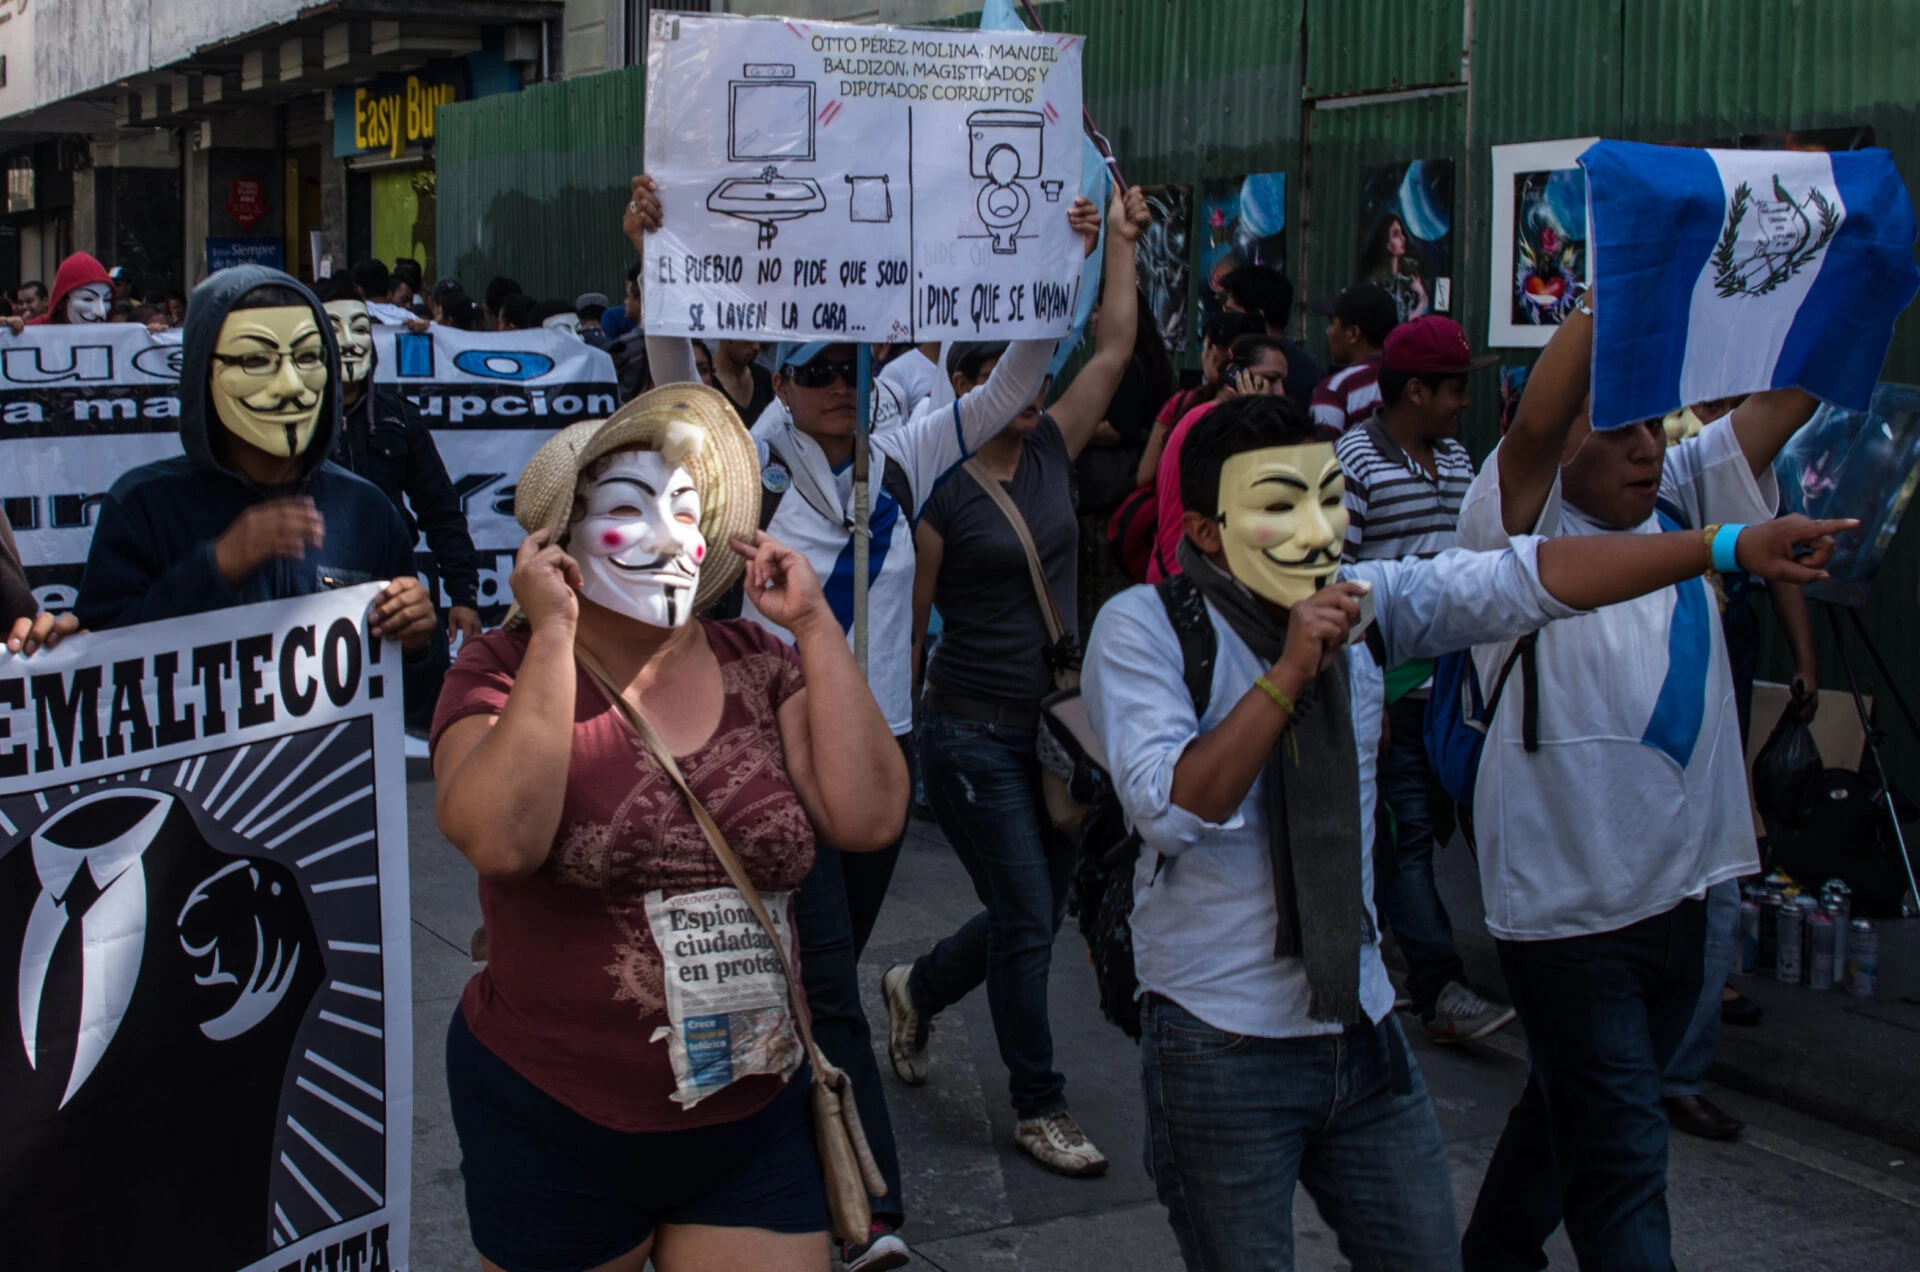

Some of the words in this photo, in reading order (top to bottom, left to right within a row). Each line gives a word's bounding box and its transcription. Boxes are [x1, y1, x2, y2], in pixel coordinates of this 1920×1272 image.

[811, 35, 857, 53] OTTO
[861, 34, 909, 55] PÉREZ
[989, 44, 1058, 62] MANUEL
[913, 62, 1036, 83] MAGISTRADOS
[1039, 67, 1049, 83] Y
[840, 80, 928, 100] DIPUTADOS
[932, 85, 1034, 104] CORRUPTOS
[355, 87, 401, 159] Easy
[231, 242, 277, 258] Siempre
[658, 256, 677, 284] EL
[685, 255, 743, 285] PUEBLO
[757, 257, 782, 285] NO
[794, 259, 827, 288] PIDE
[840, 260, 866, 288] QUE
[875, 260, 909, 288] SOLO
[689, 303, 706, 331] SE
[717, 300, 768, 331] LAVEN
[781, 302, 798, 330] LA
[971, 283, 1000, 333] QUE
[1008, 284, 1024, 322] SE
[679, 962, 708, 983] en
